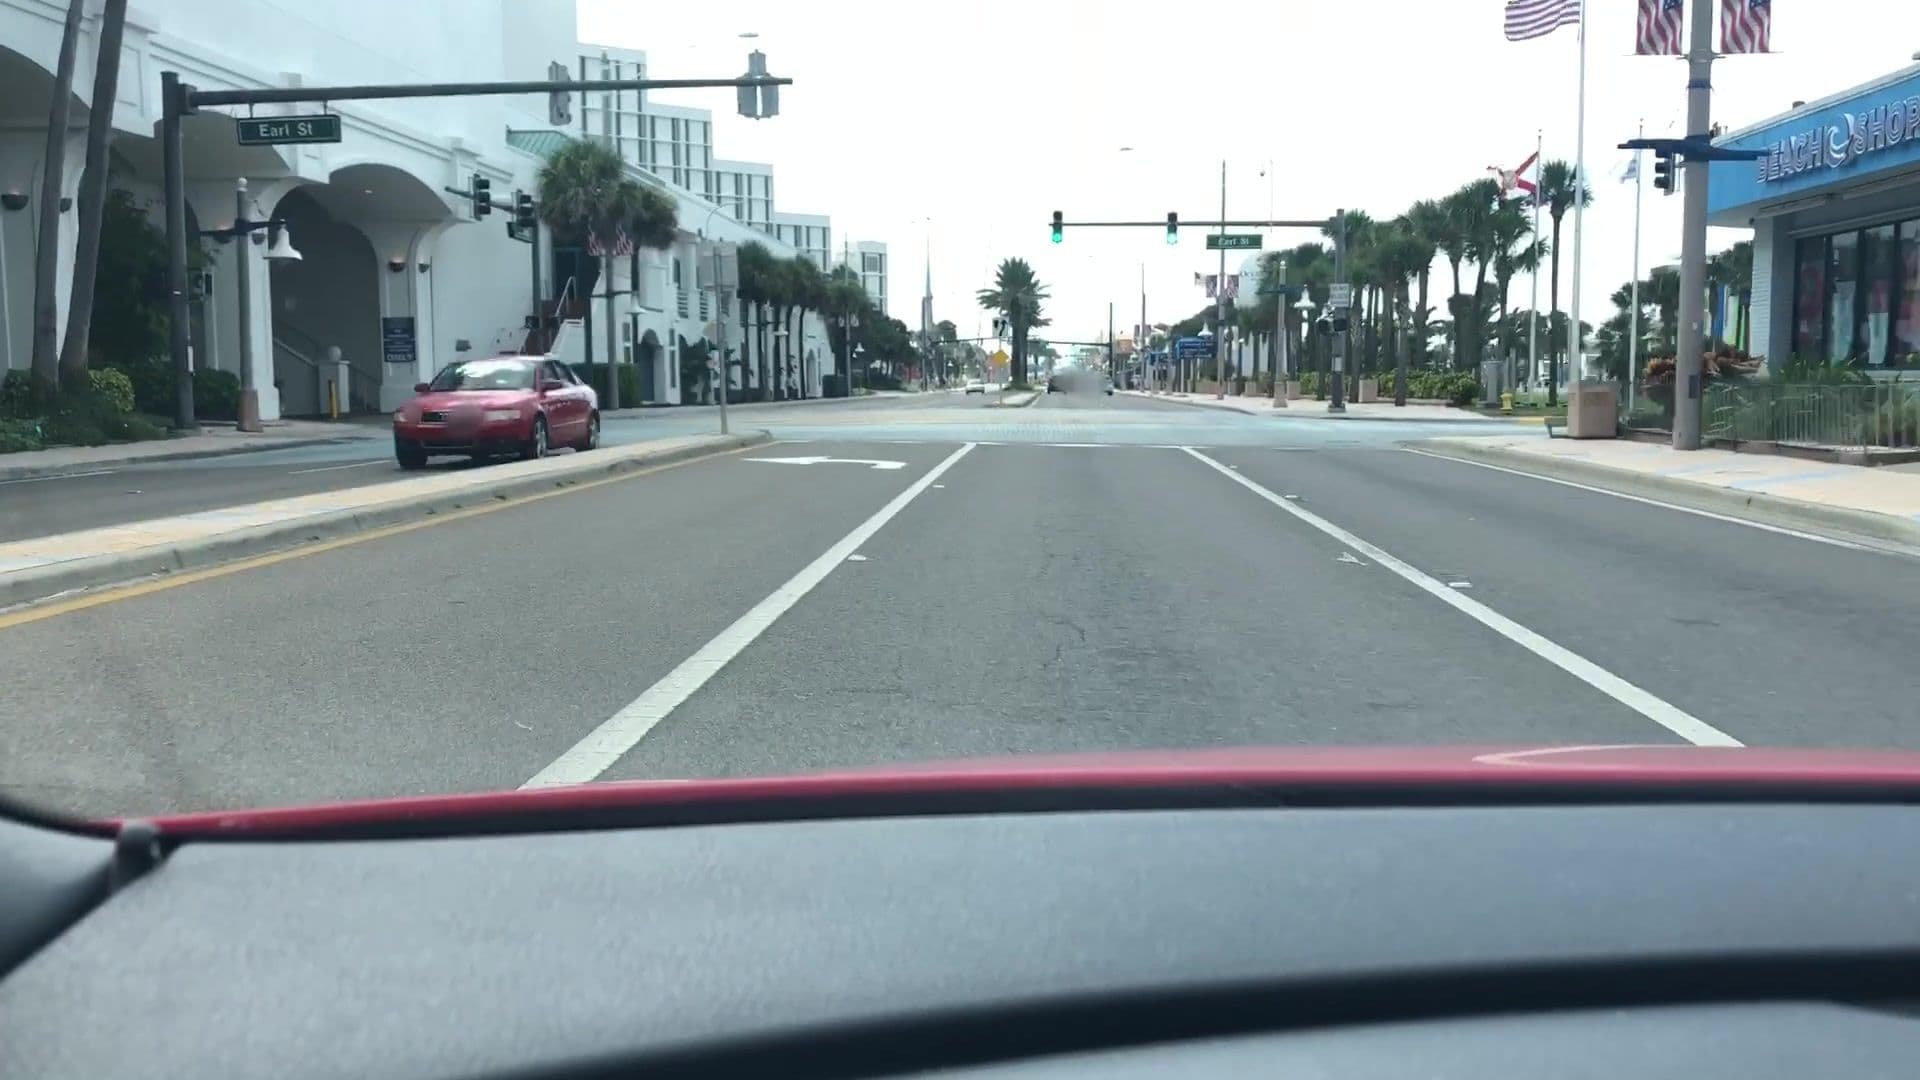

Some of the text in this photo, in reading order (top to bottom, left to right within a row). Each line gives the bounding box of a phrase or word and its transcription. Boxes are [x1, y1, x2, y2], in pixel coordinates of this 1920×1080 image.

[258, 122, 313, 137] Earl St
[1757, 97, 1920, 183] BEACH SHOP
